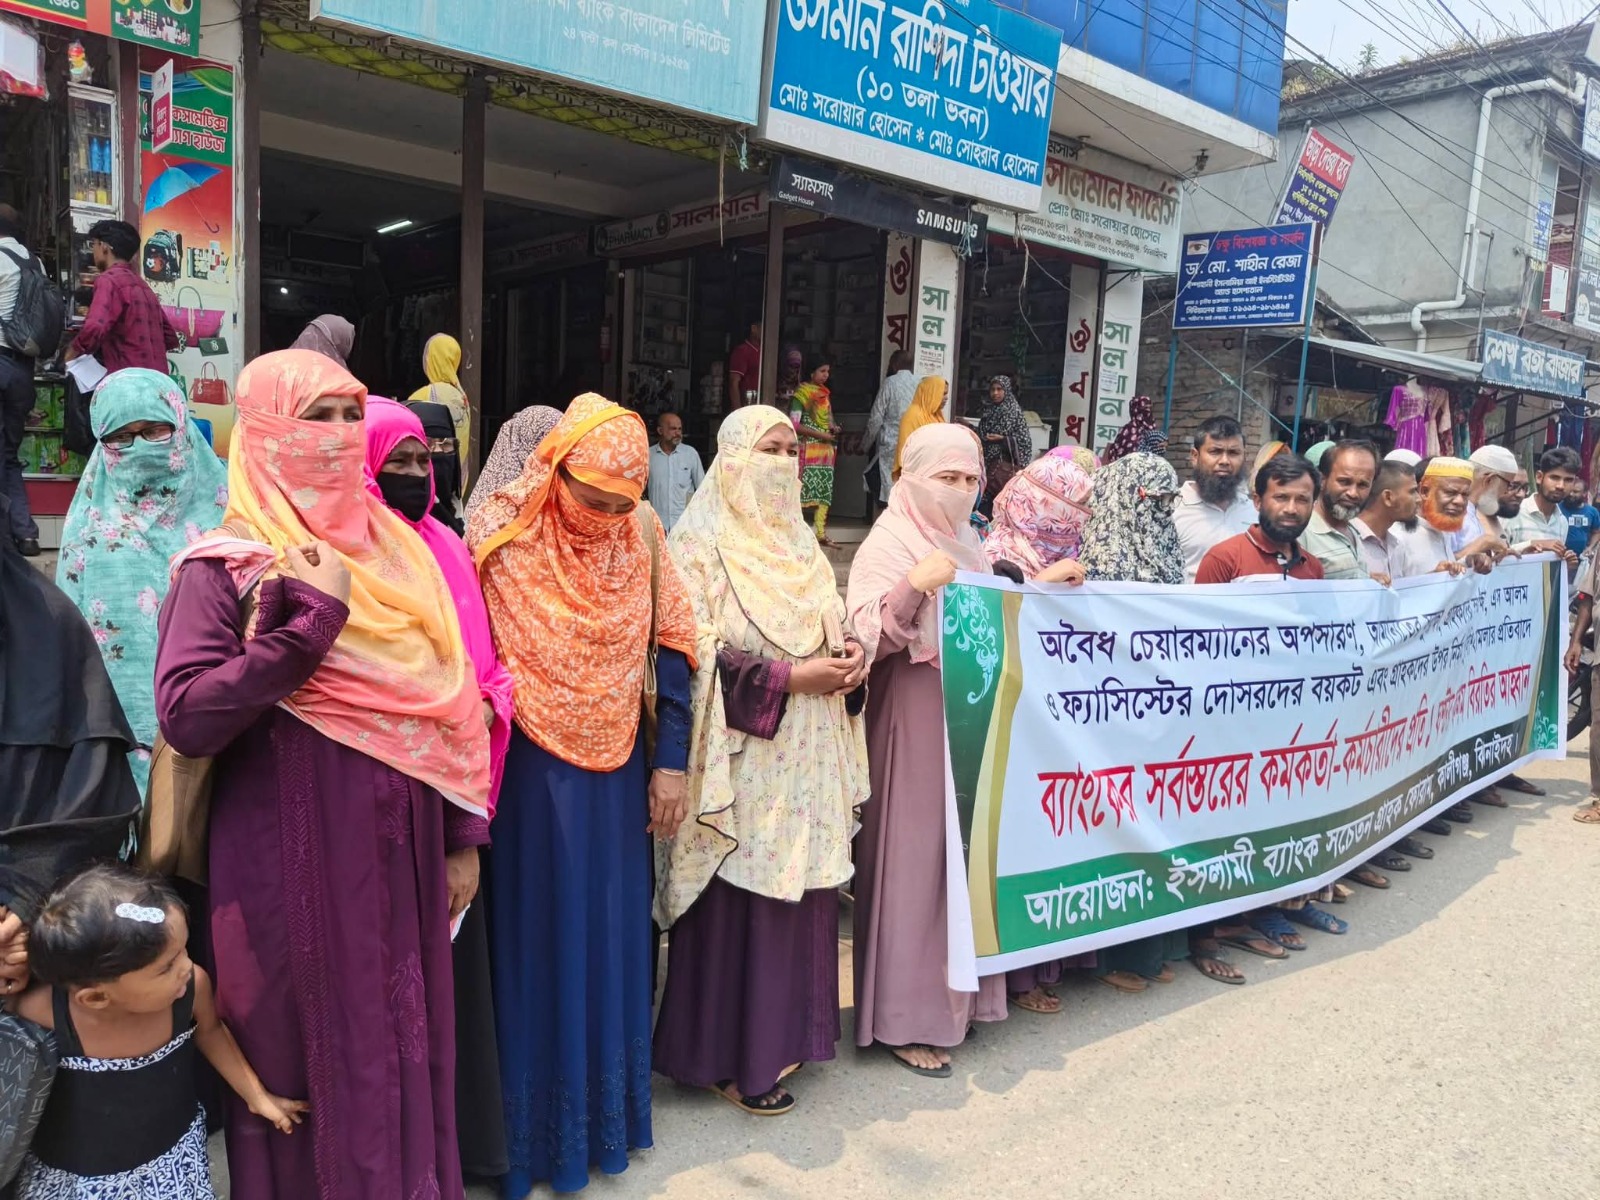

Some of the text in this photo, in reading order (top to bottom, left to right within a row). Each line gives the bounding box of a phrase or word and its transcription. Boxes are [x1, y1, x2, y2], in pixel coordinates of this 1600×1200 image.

[617, 5, 679, 43] বাংলাদেশ
[681, 19, 731, 56] লিমিটেড
[969, 24, 1053, 119] টাওয়ার
[857, 65, 989, 140] (১০ তলা ভবন)
[192, 129, 226, 153] হাউজ
[780, 83, 1039, 182] মোঃ সরোয়ার হোসেন মোঃ সোহরাব হোসেন
[778, 191, 815, 207] Gadget House
[791, 173, 834, 200] স্যামসাং
[1046, 156, 1126, 212] সালমান
[672, 192, 761, 229] সালমান
[916, 209, 978, 238] SAMSUNG
[1071, 206, 1090, 223] মোঃ
[1091, 212, 1129, 235] সরোয়ার
[1130, 224, 1161, 245] হোসেন
[608, 226, 654, 248] PHARMACY
[1208, 260, 1231, 274] মো.
[1235, 253, 1269, 272] শাহীন
[1271, 254, 1303, 270] রেজা
[1485, 336, 1519, 370] শেখ
[1037, 619, 1118, 664] অবৈধ
[1131, 622, 1270, 662] চেয়ারম্যানের
[1276, 619, 1366, 657] অপসারণ,
[1503, 584, 1529, 607] আলম
[1057, 676, 1194, 725] ফ্যাসিস্টের
[1203, 678, 1305, 716] দোসরদের
[1311, 662, 1364, 705] বয়কট
[1367, 668, 1389, 697] এবং
[1389, 652, 1430, 691] গ্রাহকদের
[1497, 613, 1532, 642] প্রতিবাদে
[1037, 761, 1139, 838] ব্যাংকের
[1144, 734, 1254, 822] সর্বস্তরের
[1024, 868, 1154, 932] আয়োজন:
[1165, 836, 1257, 904] ইসলামী
[1263, 833, 1322, 879] ব্যাংক
[1325, 811, 1375, 860] সচেতন
[1374, 794, 1404, 835] গ্রাহক
[1437, 749, 1472, 791] কালীগঞ্জ,
